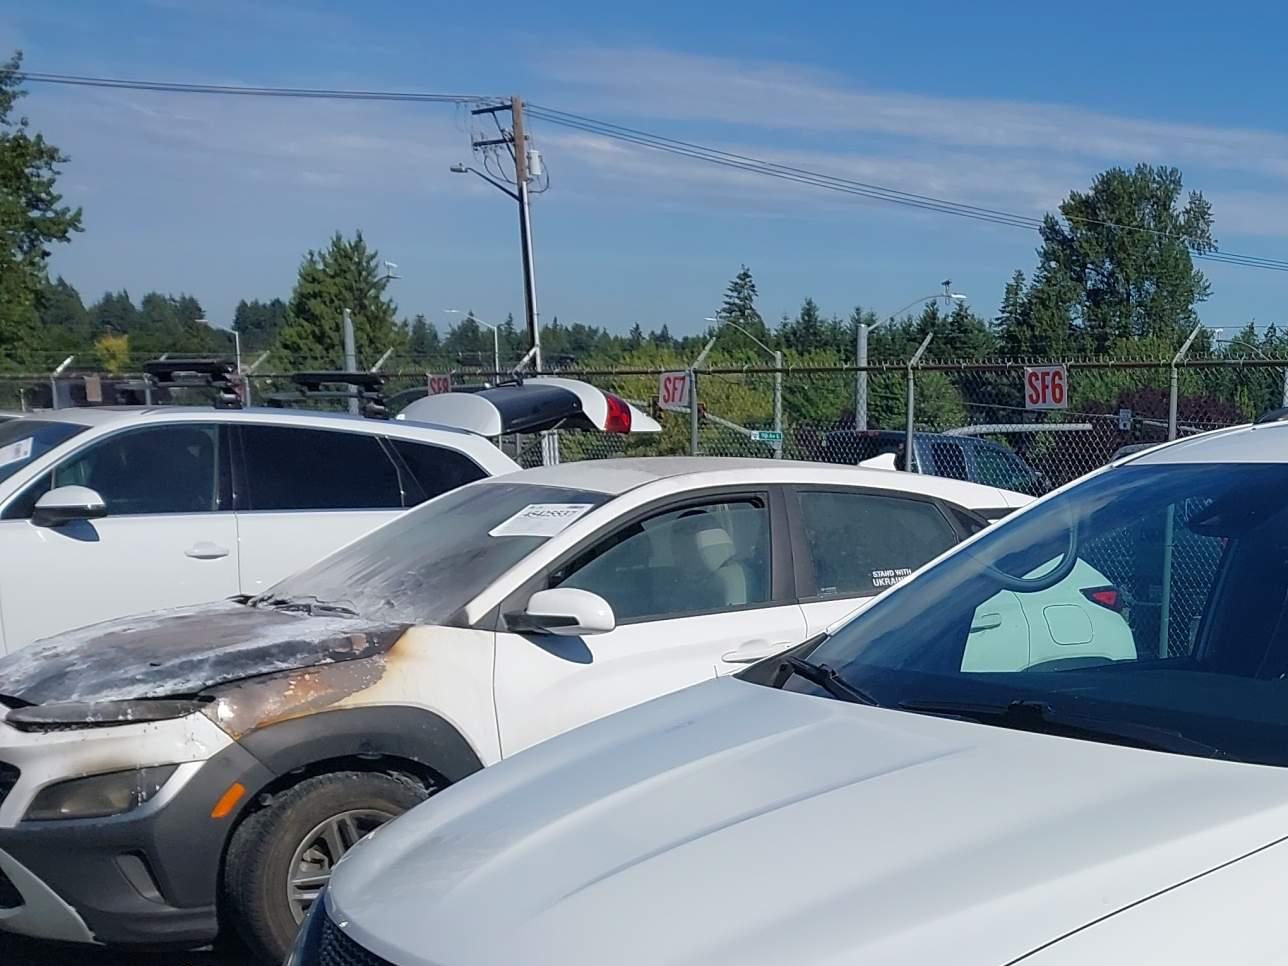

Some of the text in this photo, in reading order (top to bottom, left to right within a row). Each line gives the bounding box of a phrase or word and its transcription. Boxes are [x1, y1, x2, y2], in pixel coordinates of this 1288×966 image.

[663, 376, 686, 403] SF7
[1028, 371, 1064, 404] SF6
[872, 568, 912, 578] STAND WITH
